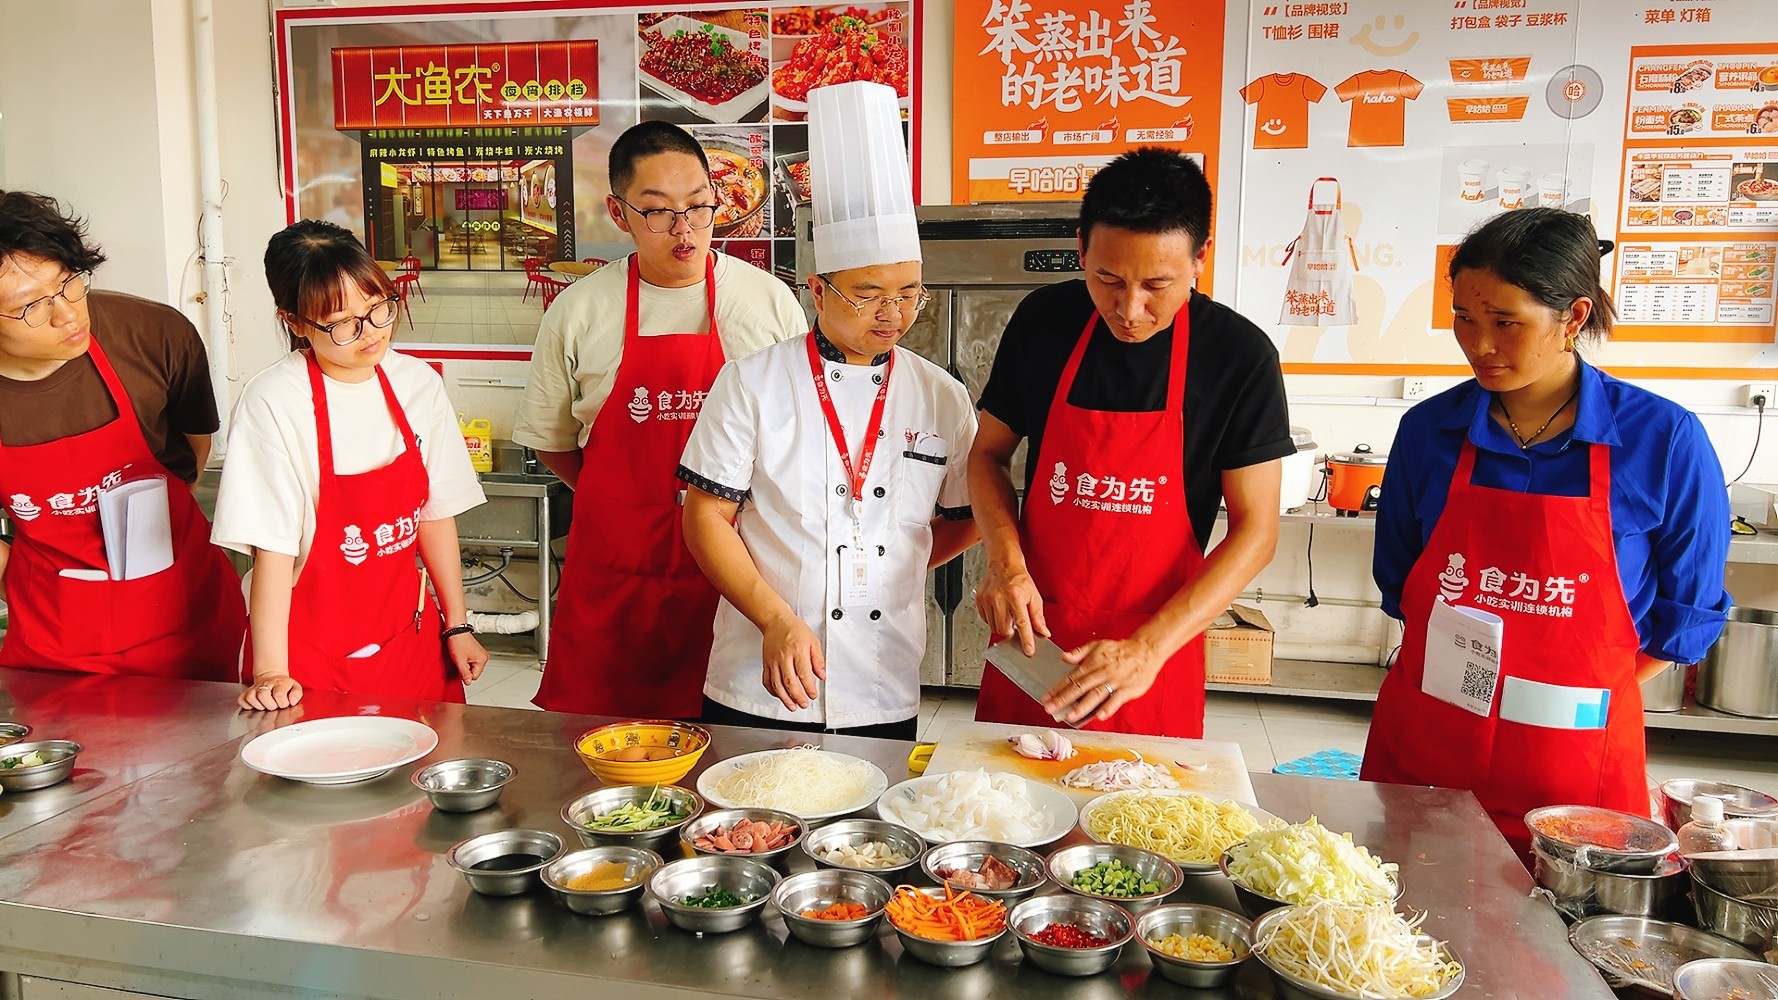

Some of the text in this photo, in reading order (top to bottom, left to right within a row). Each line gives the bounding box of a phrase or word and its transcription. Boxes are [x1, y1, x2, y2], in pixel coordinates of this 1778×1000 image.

[1450, 12, 1567, 30] 打包盒 袋子 豆浆杯
[1644, 8, 1711, 24] 菜单 灯箱
[978, 0, 1163, 65] 笨蒸出来
[1262, 23, 1339, 40] T恤衫 围裙
[1001, 36, 1193, 113] 的老味道
[375, 61, 493, 106] 大渔农
[503, 82, 585, 98] 夜宵排档
[1363, 92, 1397, 104] haha
[993, 132, 1030, 142] 整店输出
[1063, 132, 1100, 142] 市场广阔
[1136, 130, 1175, 140] 无需经验
[1077, 473, 1155, 503] 食为先
[51, 505, 98, 515] 小吃实训
[1073, 498, 1152, 514] 小吃实训连锁机构
[1479, 566, 1575, 604] 食为先
[1474, 594, 1573, 617] 小吃实训连锁机构
